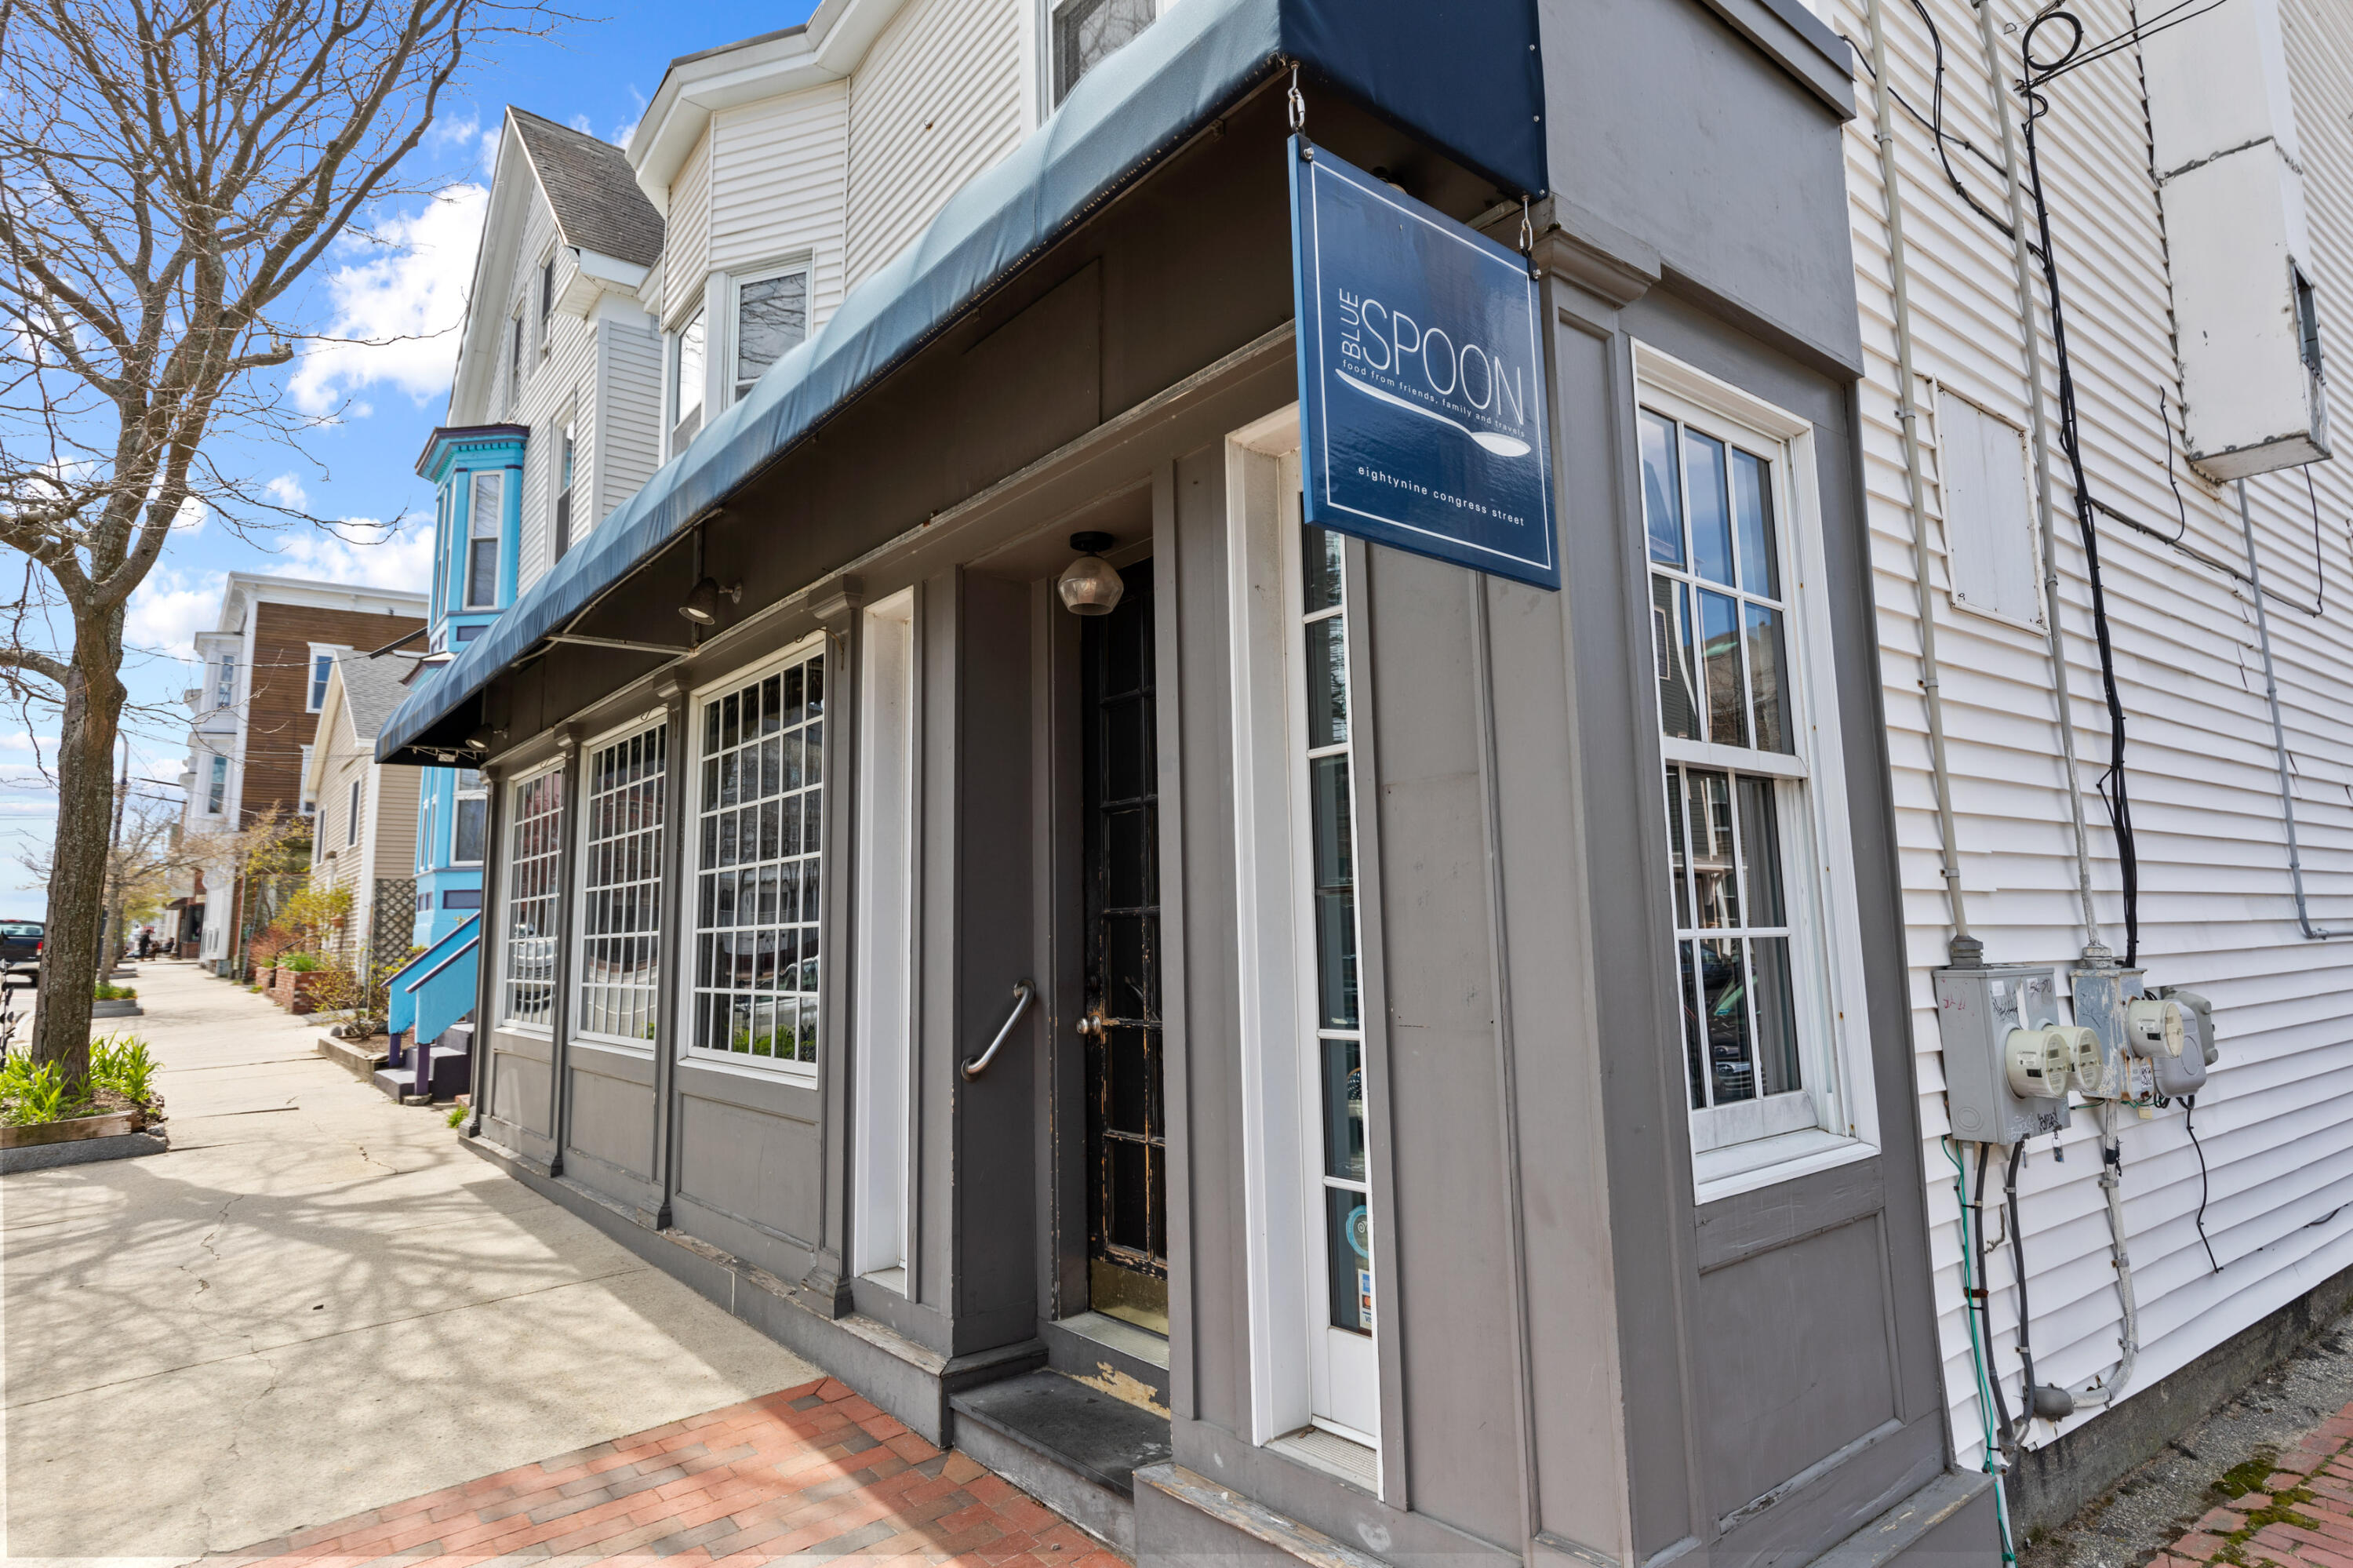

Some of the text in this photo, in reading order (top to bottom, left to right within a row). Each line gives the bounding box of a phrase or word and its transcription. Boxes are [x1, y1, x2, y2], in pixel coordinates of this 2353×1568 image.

[1339, 288, 1361, 360] BLUE
[1343, 359, 1525, 438] food from friends, family and travels
[1362, 299, 1523, 425] SPOON
[1358, 467, 1524, 526] eightynine congress street
